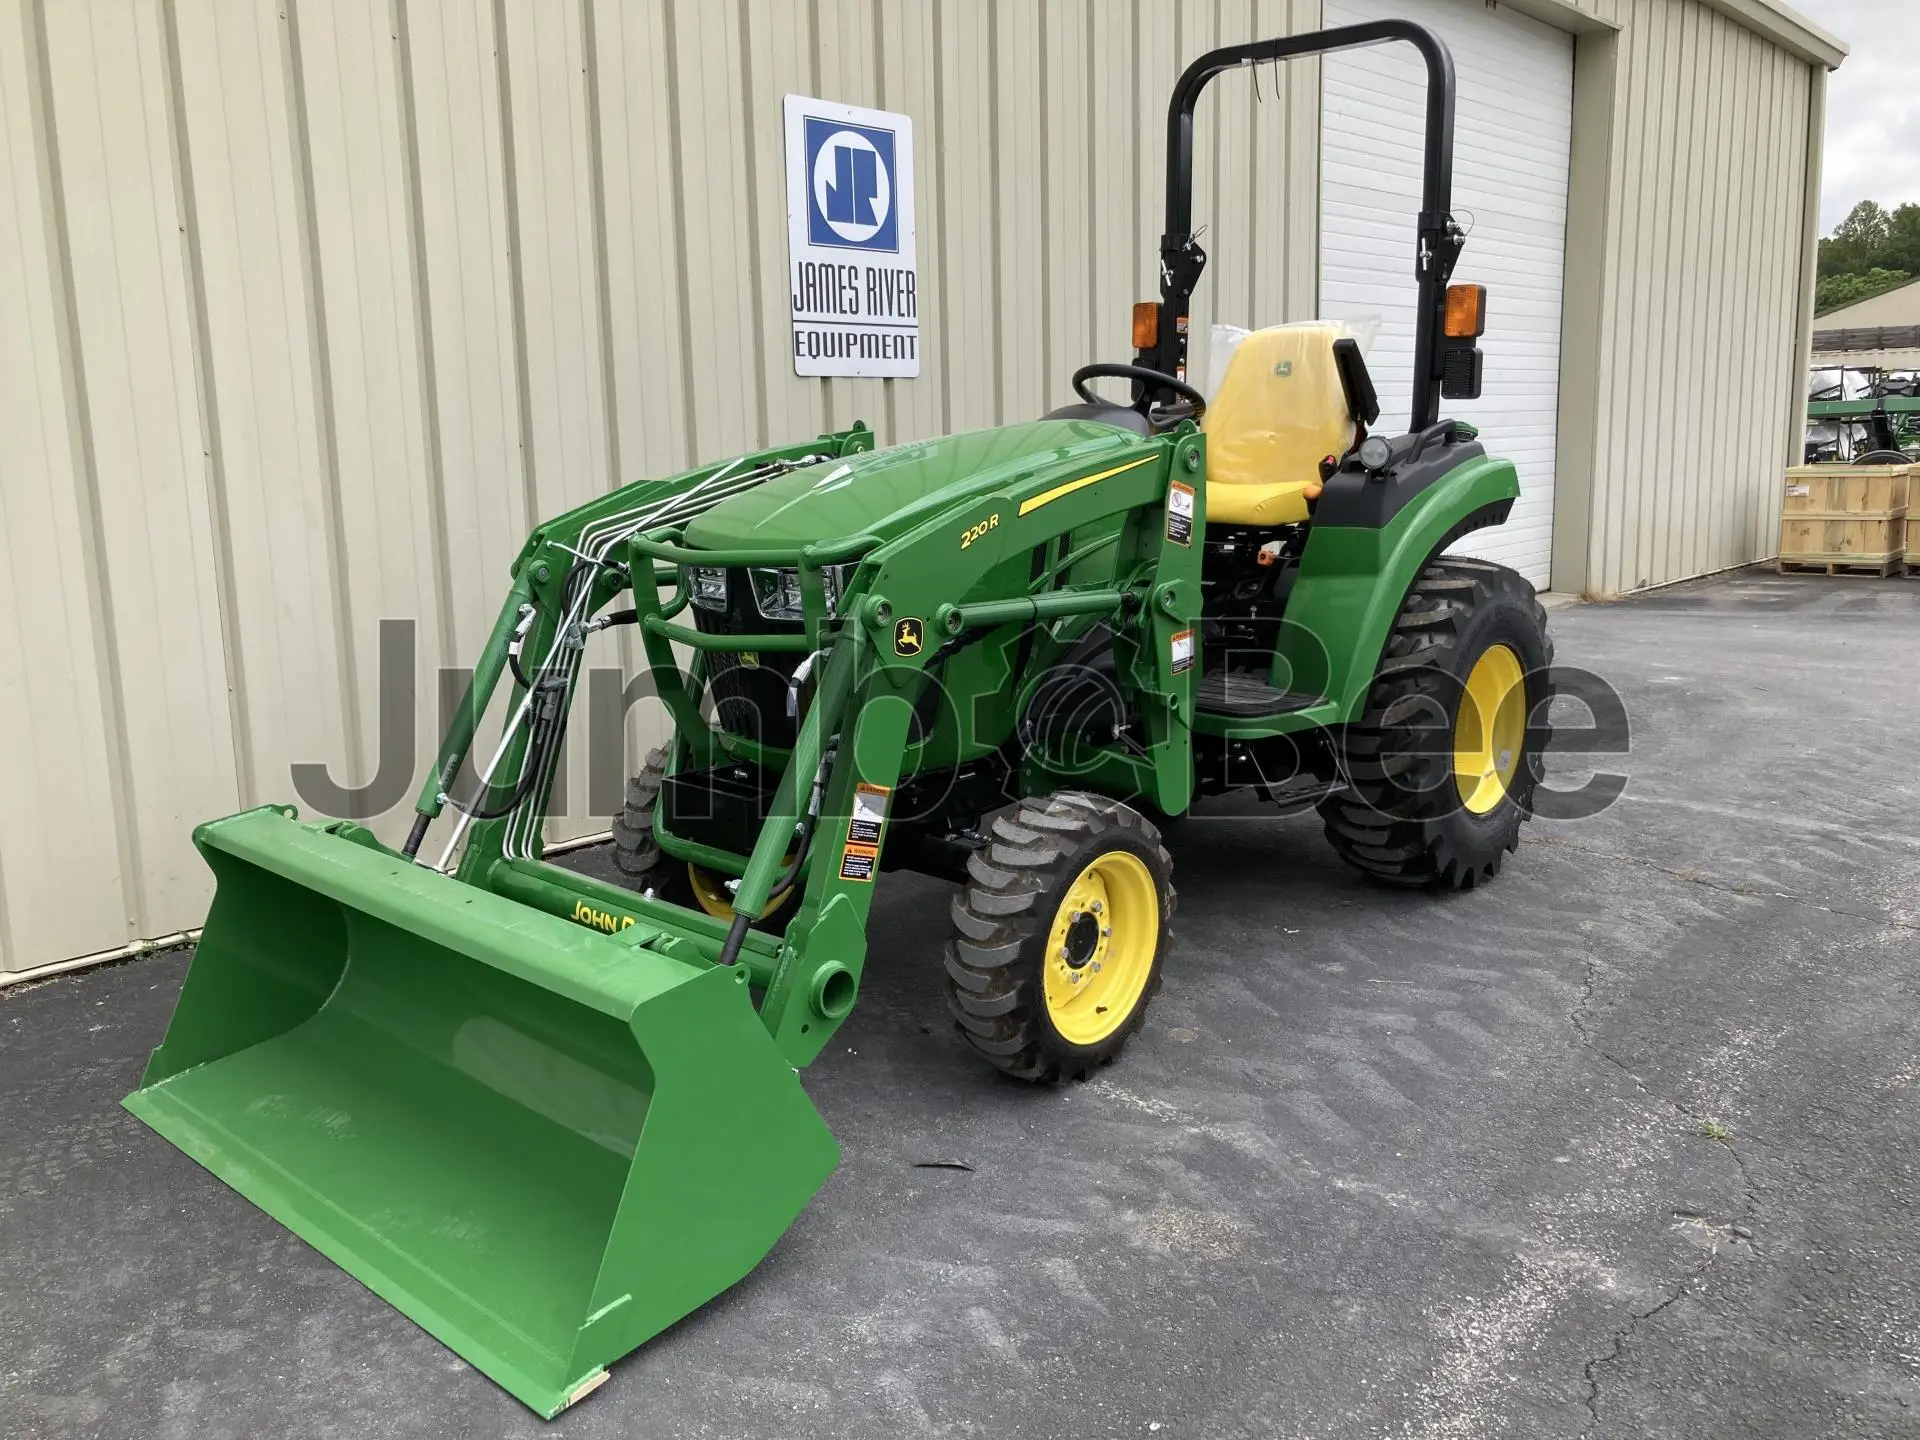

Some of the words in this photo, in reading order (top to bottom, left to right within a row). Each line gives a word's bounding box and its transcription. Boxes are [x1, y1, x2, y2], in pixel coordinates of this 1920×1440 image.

[793, 261, 859, 316] JAMES
[866, 267, 916, 318] RIVER
[795, 330, 917, 360] EQUIPMENT
[853, 847, 874, 856] WARNING
[570, 900, 617, 933] JOHN
